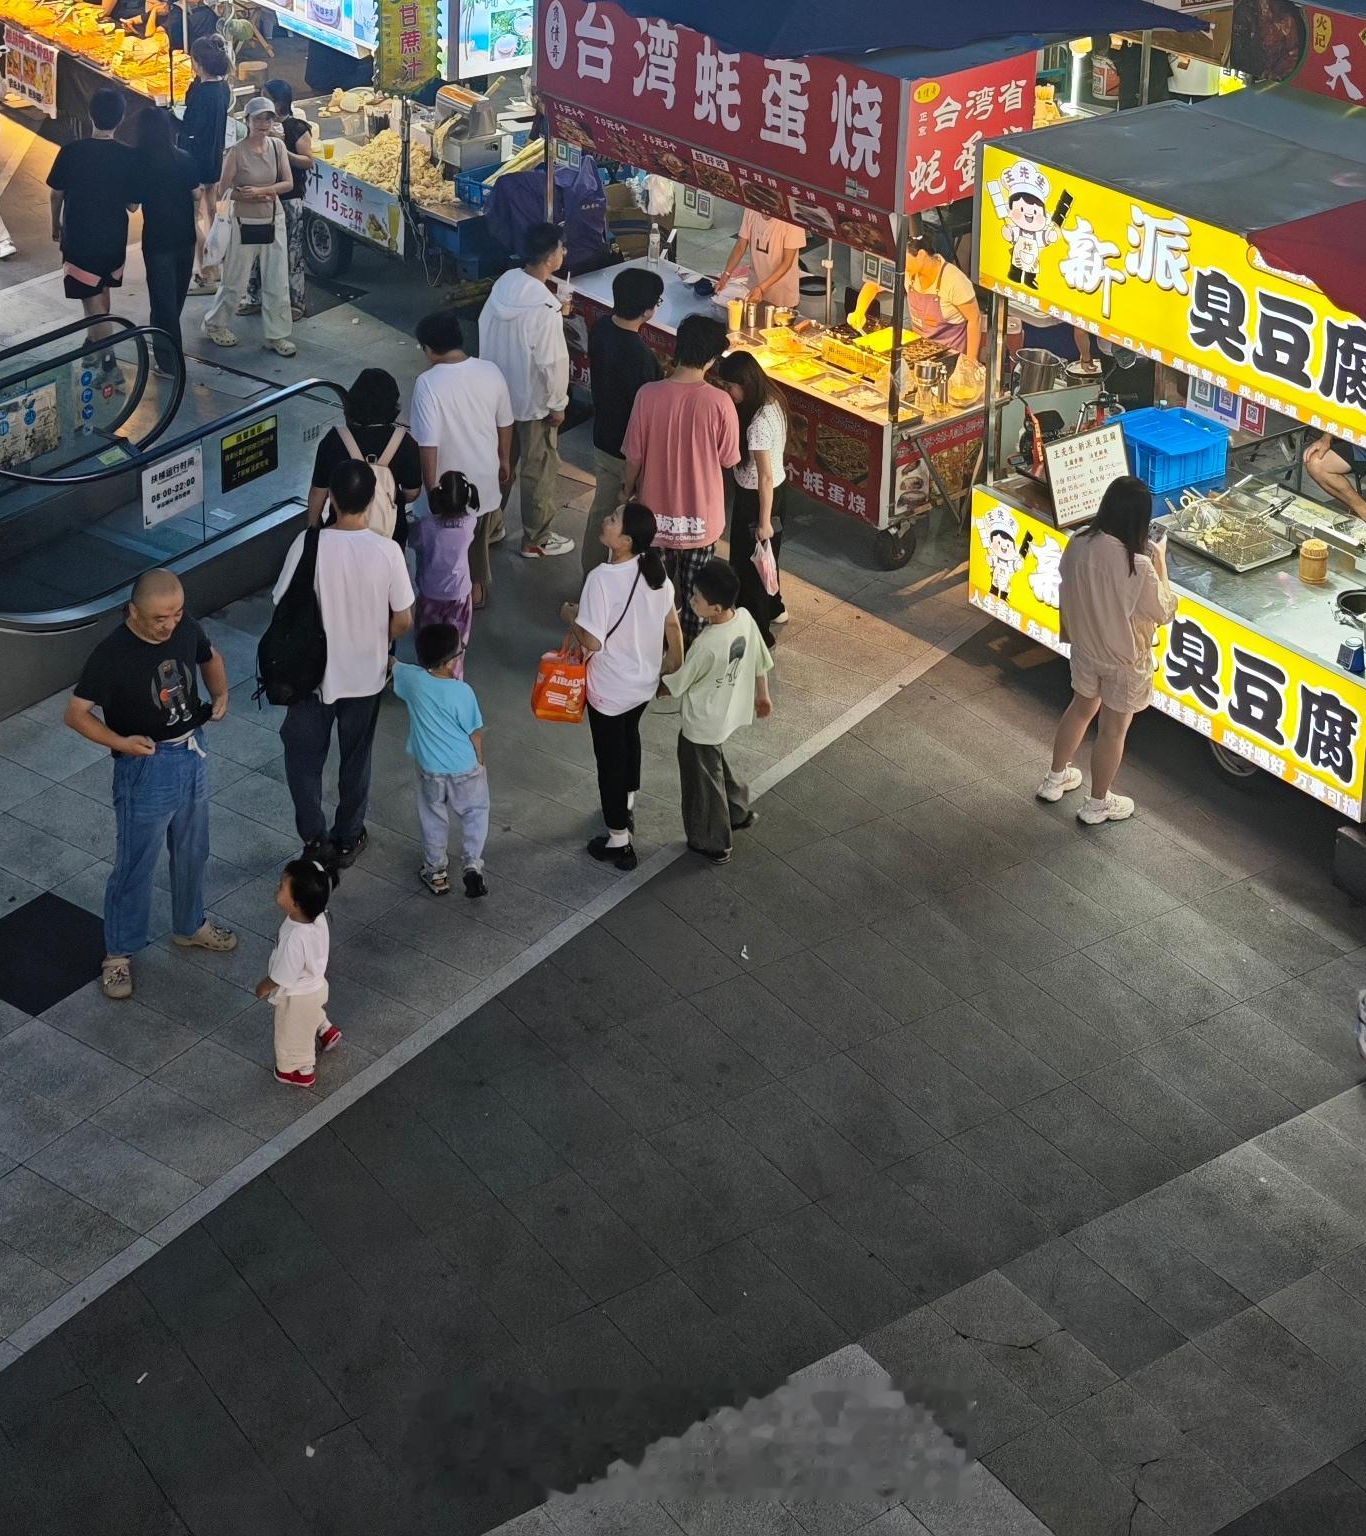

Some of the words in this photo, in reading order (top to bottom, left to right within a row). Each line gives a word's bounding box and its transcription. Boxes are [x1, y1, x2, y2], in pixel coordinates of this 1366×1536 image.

[399, 4, 422, 83] 甘蔗汁
[575, 3, 884, 178] 台湾蚝蛋烧
[933, 79, 1027, 132] 台湾省
[331, 171, 364, 203] 8元1杯
[1003, 165, 1048, 194] 王先生
[324, 190, 364, 224] 15元2杯
[1059, 205, 1193, 319] 新派
[151, 456, 195, 485] 扶梯运行时间
[151, 476, 196, 504] 08:00-22:00
[1164, 618, 1361, 784] 臭豆腐
